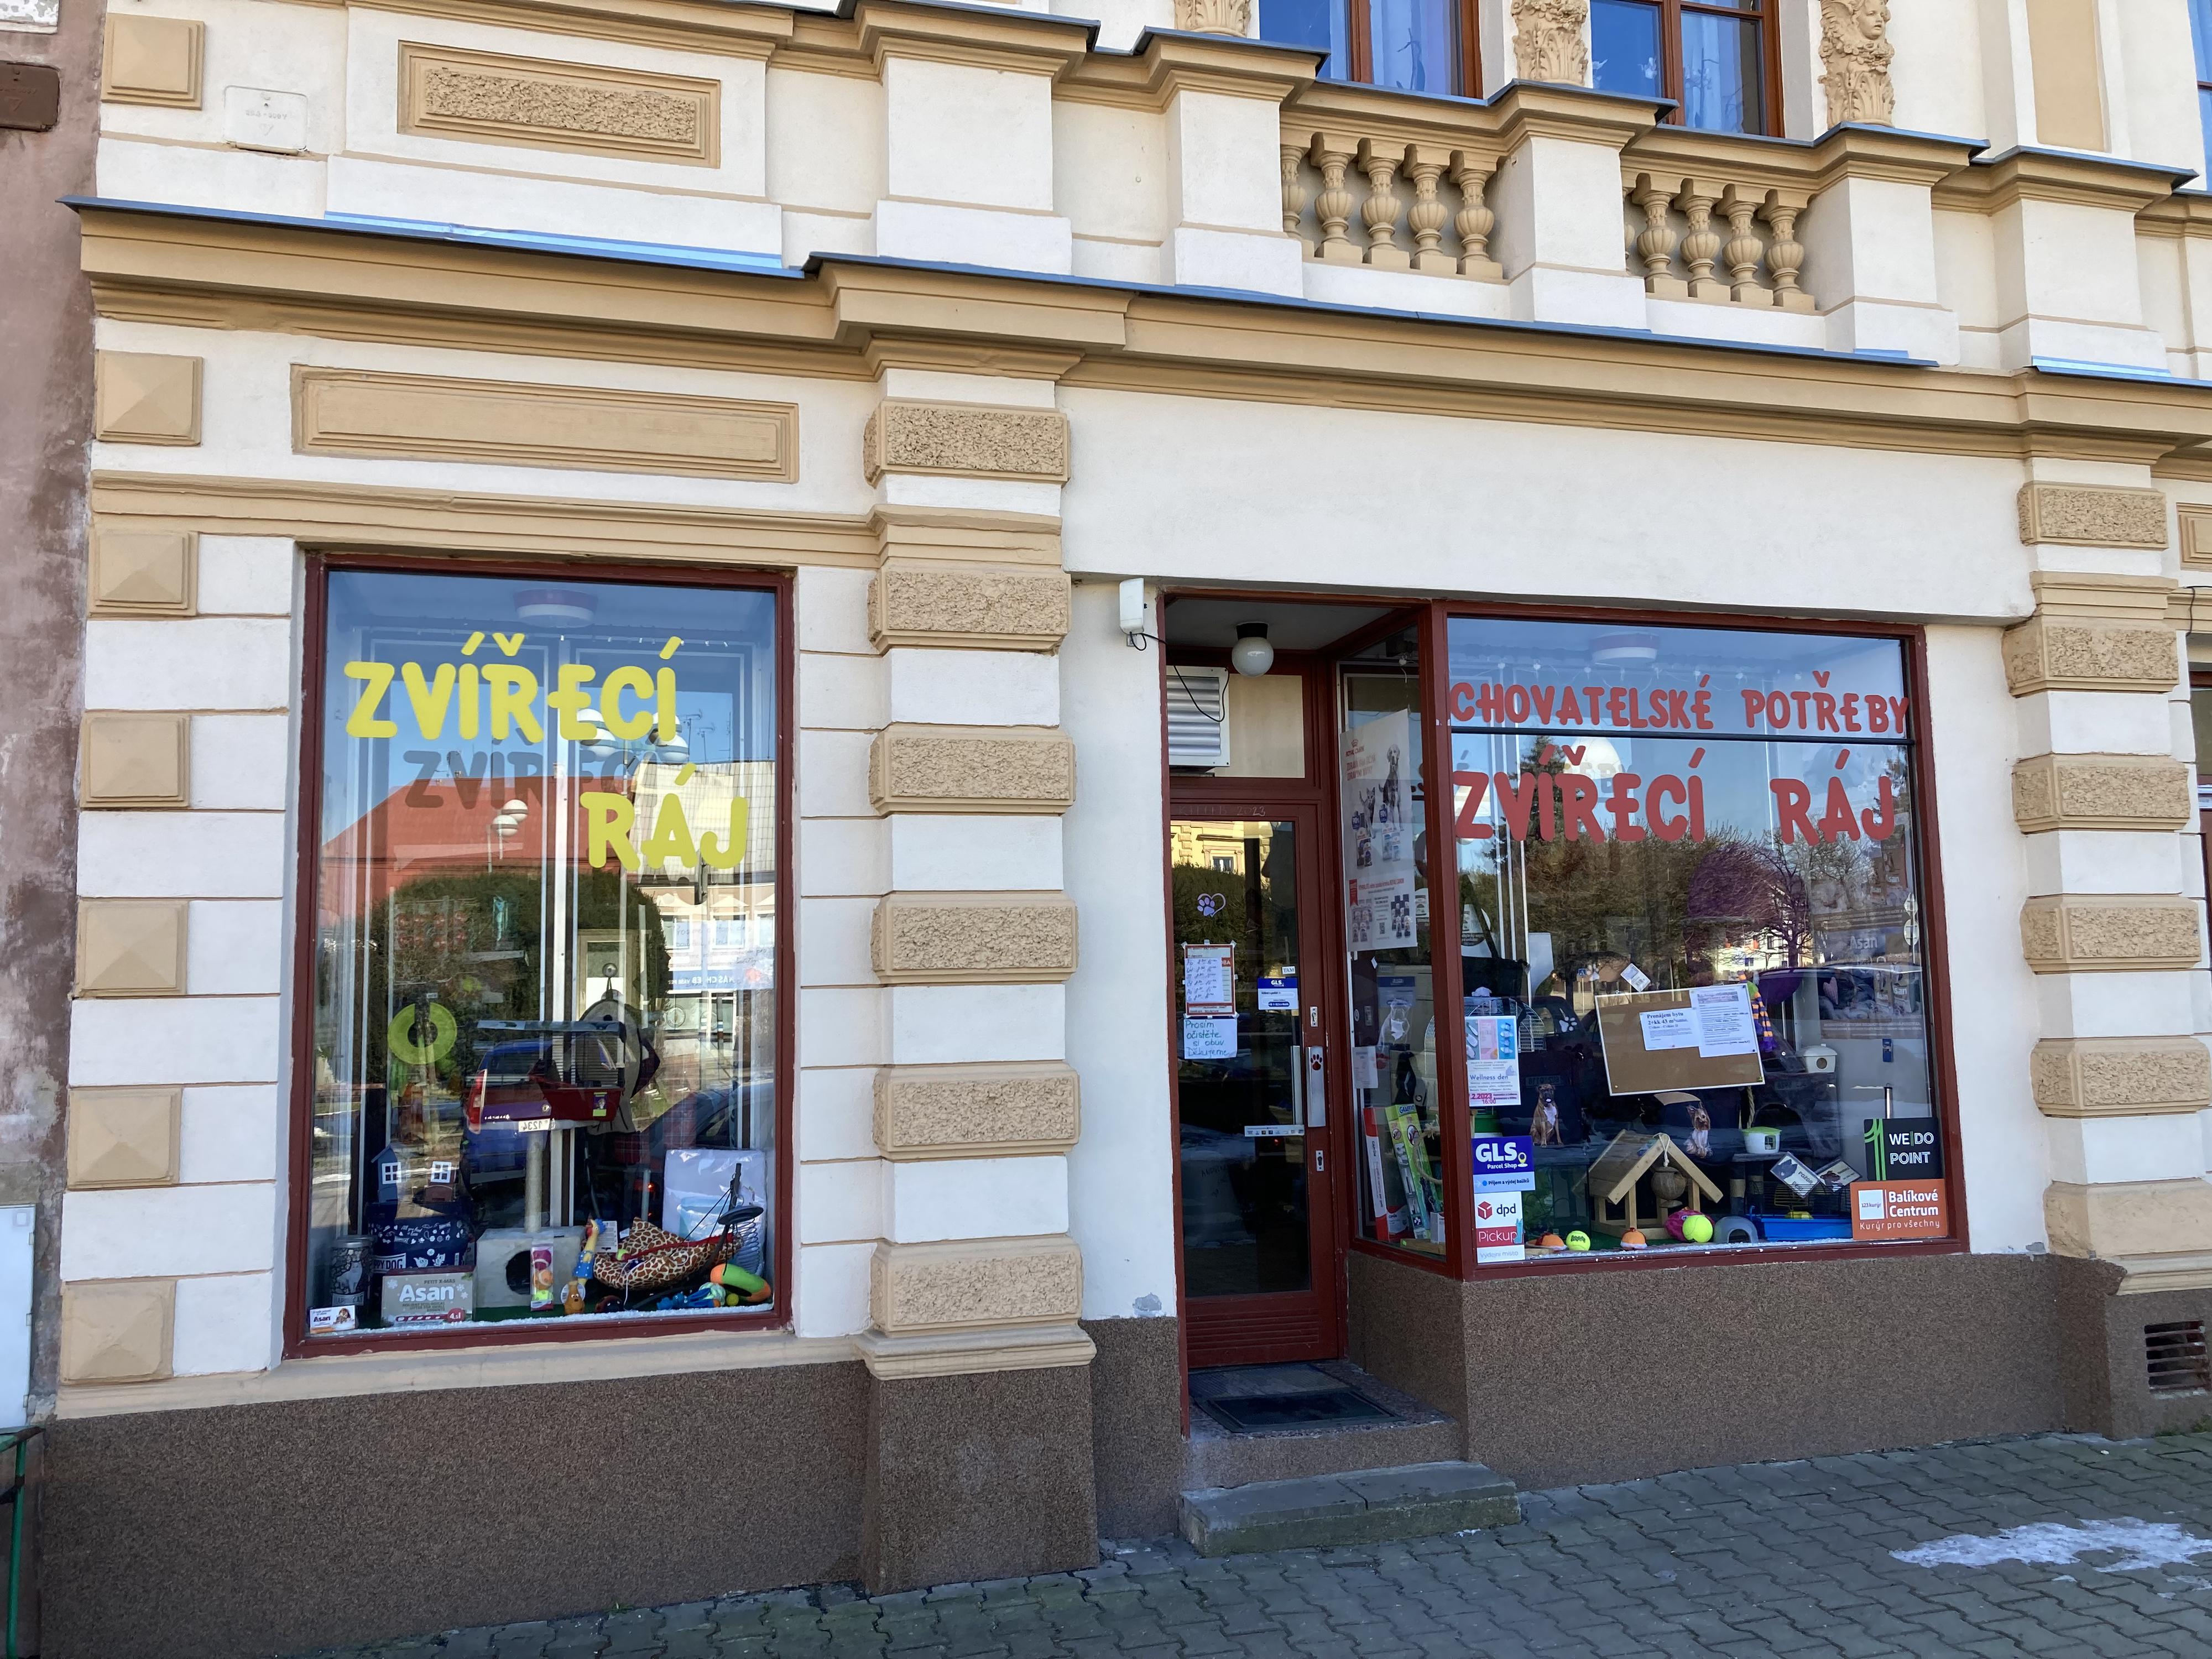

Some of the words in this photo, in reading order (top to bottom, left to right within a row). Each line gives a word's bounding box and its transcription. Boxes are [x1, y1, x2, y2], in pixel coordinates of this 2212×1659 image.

[344, 632, 682, 744] ZVÍŘECÍ
[1449, 674, 1714, 729] CHOVATELSKÉ
[1741, 670, 1910, 734] POTŘEBY
[1452, 744, 1705, 844] ZVÍŘECÍ
[1770, 749, 1895, 846] RÁJ
[580, 763, 748, 870] RÁJ
[1850, 935, 1878, 950] Asan
[1185, 1020, 1214, 1029] Prosím
[1475, 1142, 1517, 1162] GLS
[1890, 1151, 1931, 1165] POINT
[1888, 1189, 1938, 1203] Balíkové
[1496, 1203, 1516, 1217] dpd
[1889, 1206, 1938, 1217] Centrum
[1860, 1221, 1885, 1232] Kurýr
[1887, 1222, 1901, 1230] pro
[1904, 1219, 1940, 1229] všechny
[1478, 1230, 1517, 1243] Pickup
[386, 1259, 403, 1269] DOG
[399, 1284, 455, 1302] Asan
